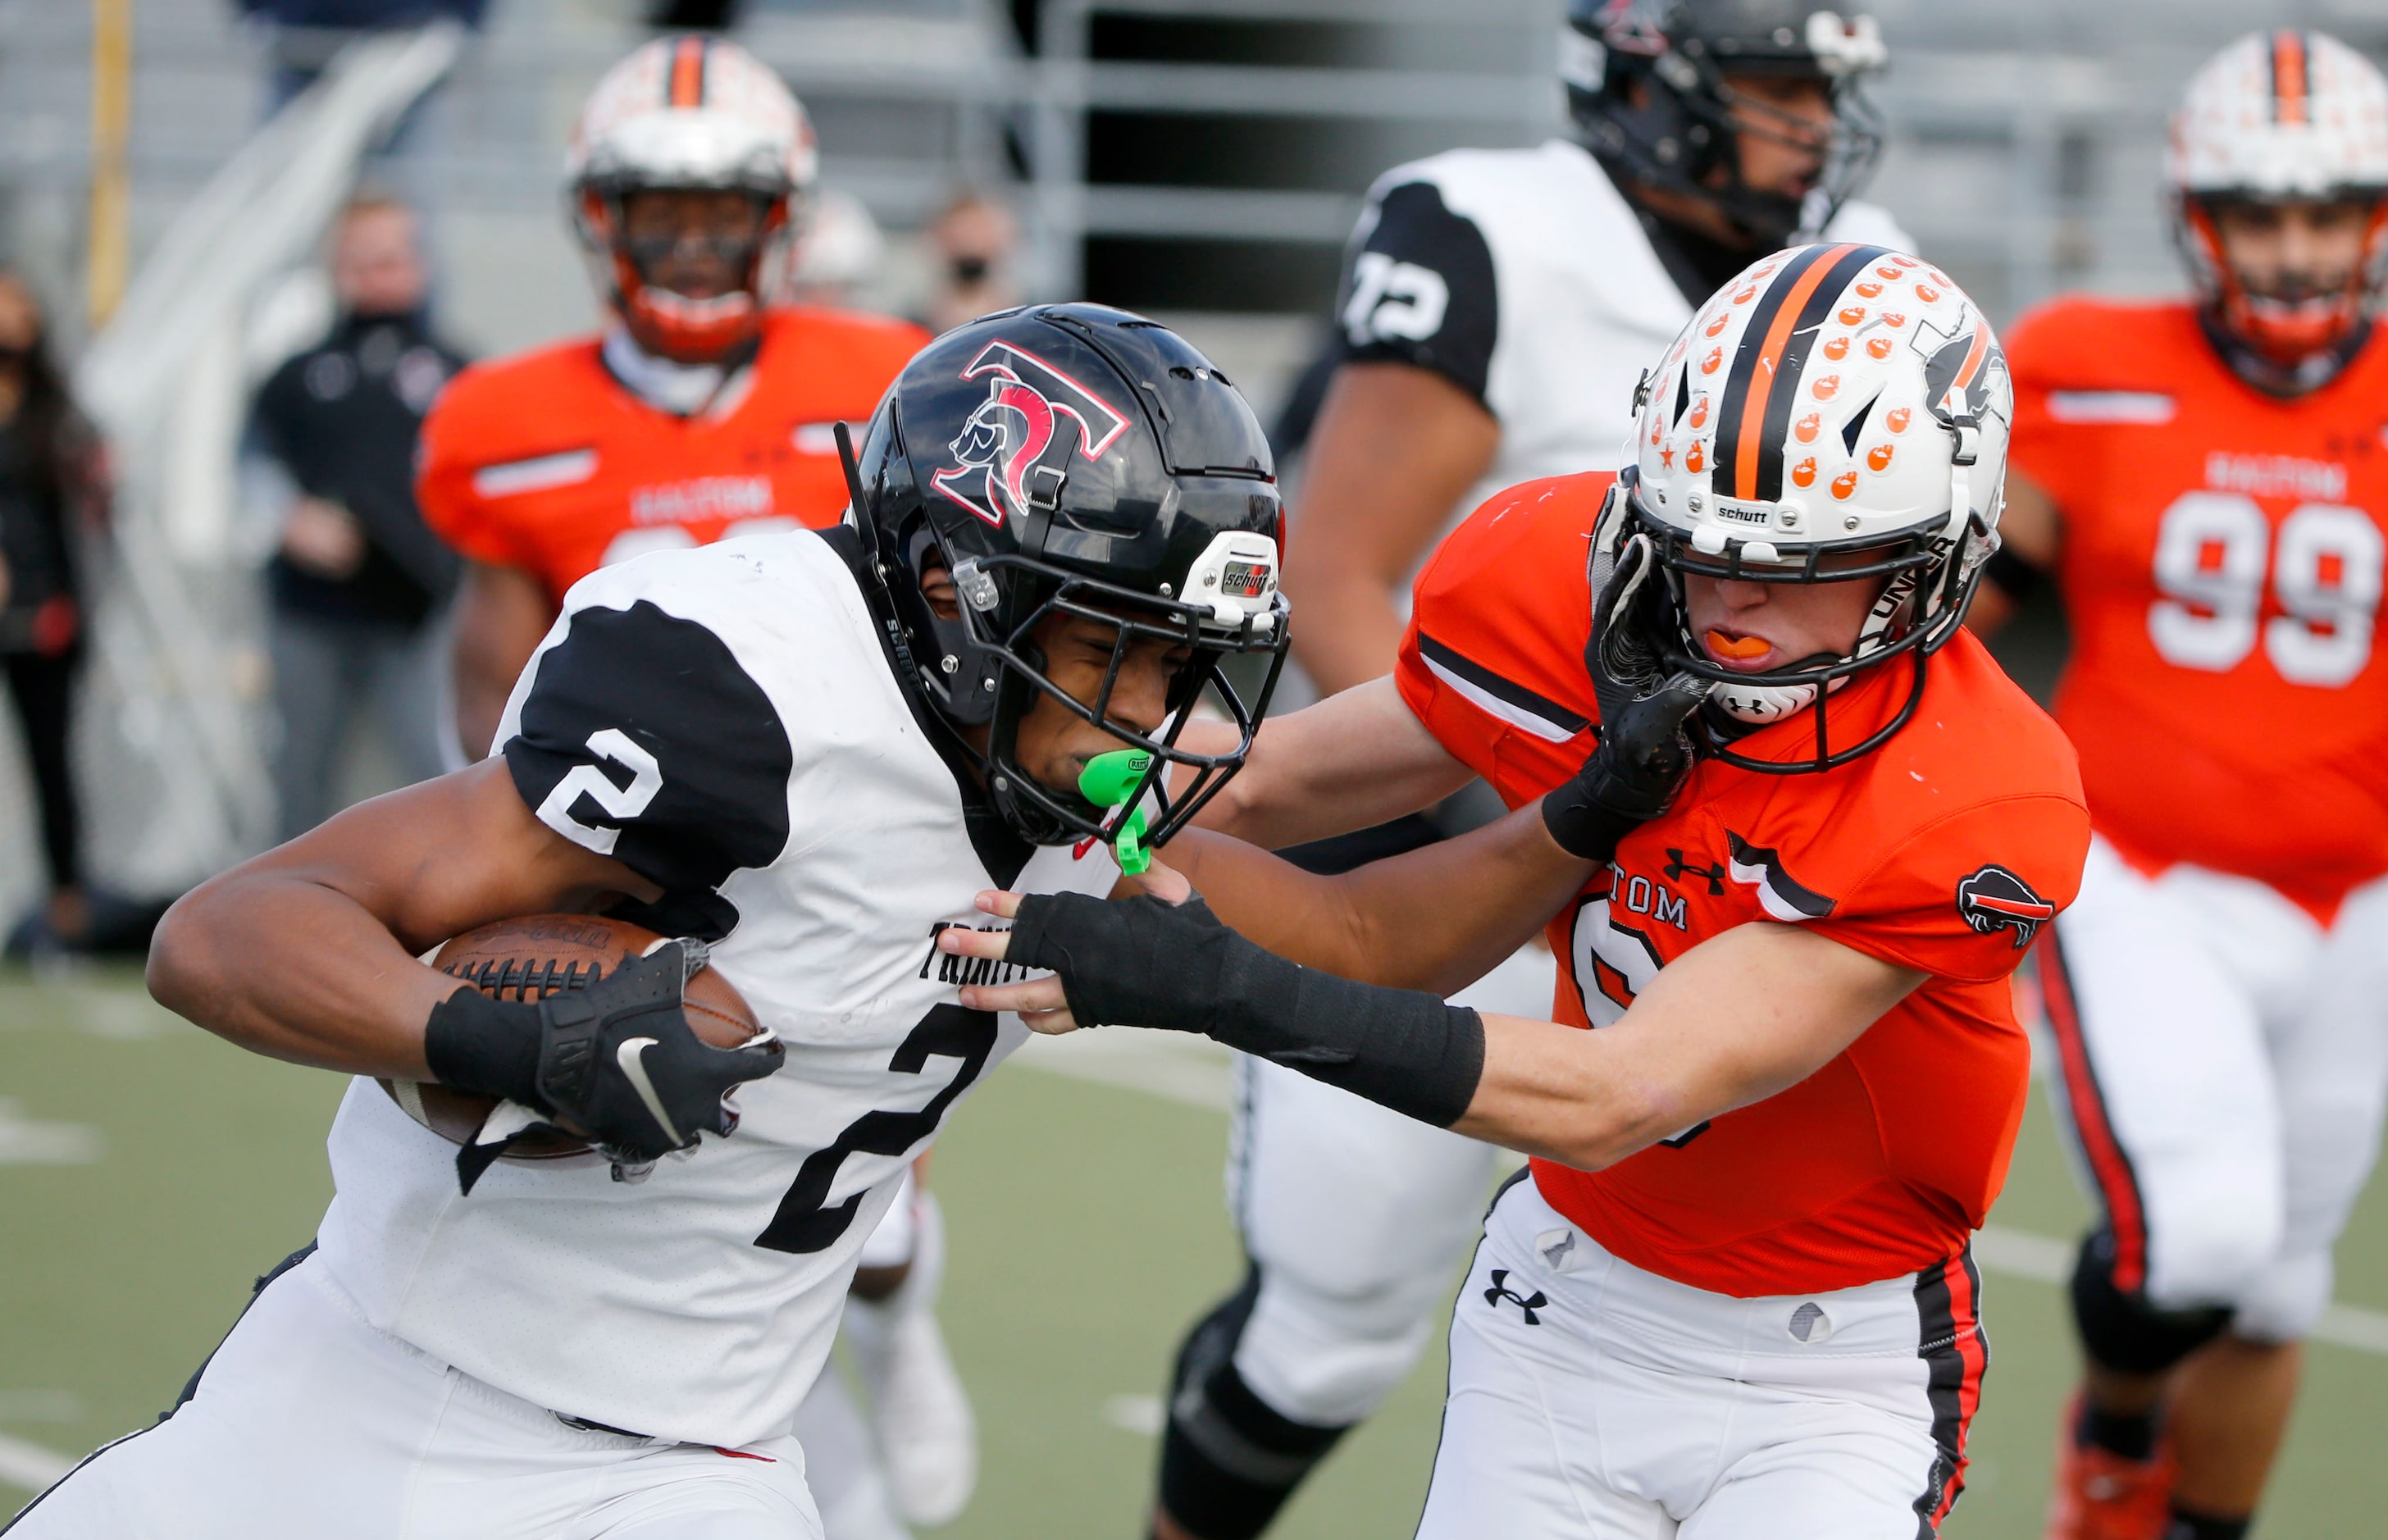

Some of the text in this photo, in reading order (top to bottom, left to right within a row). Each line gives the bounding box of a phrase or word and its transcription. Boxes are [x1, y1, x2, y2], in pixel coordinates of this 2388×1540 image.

[1718, 508, 1766, 522] schutt
[2146, 489, 2386, 690] 99
[535, 727, 663, 855] 2
[1605, 859, 1688, 932] TOM
[753, 1002, 998, 1255] 2
